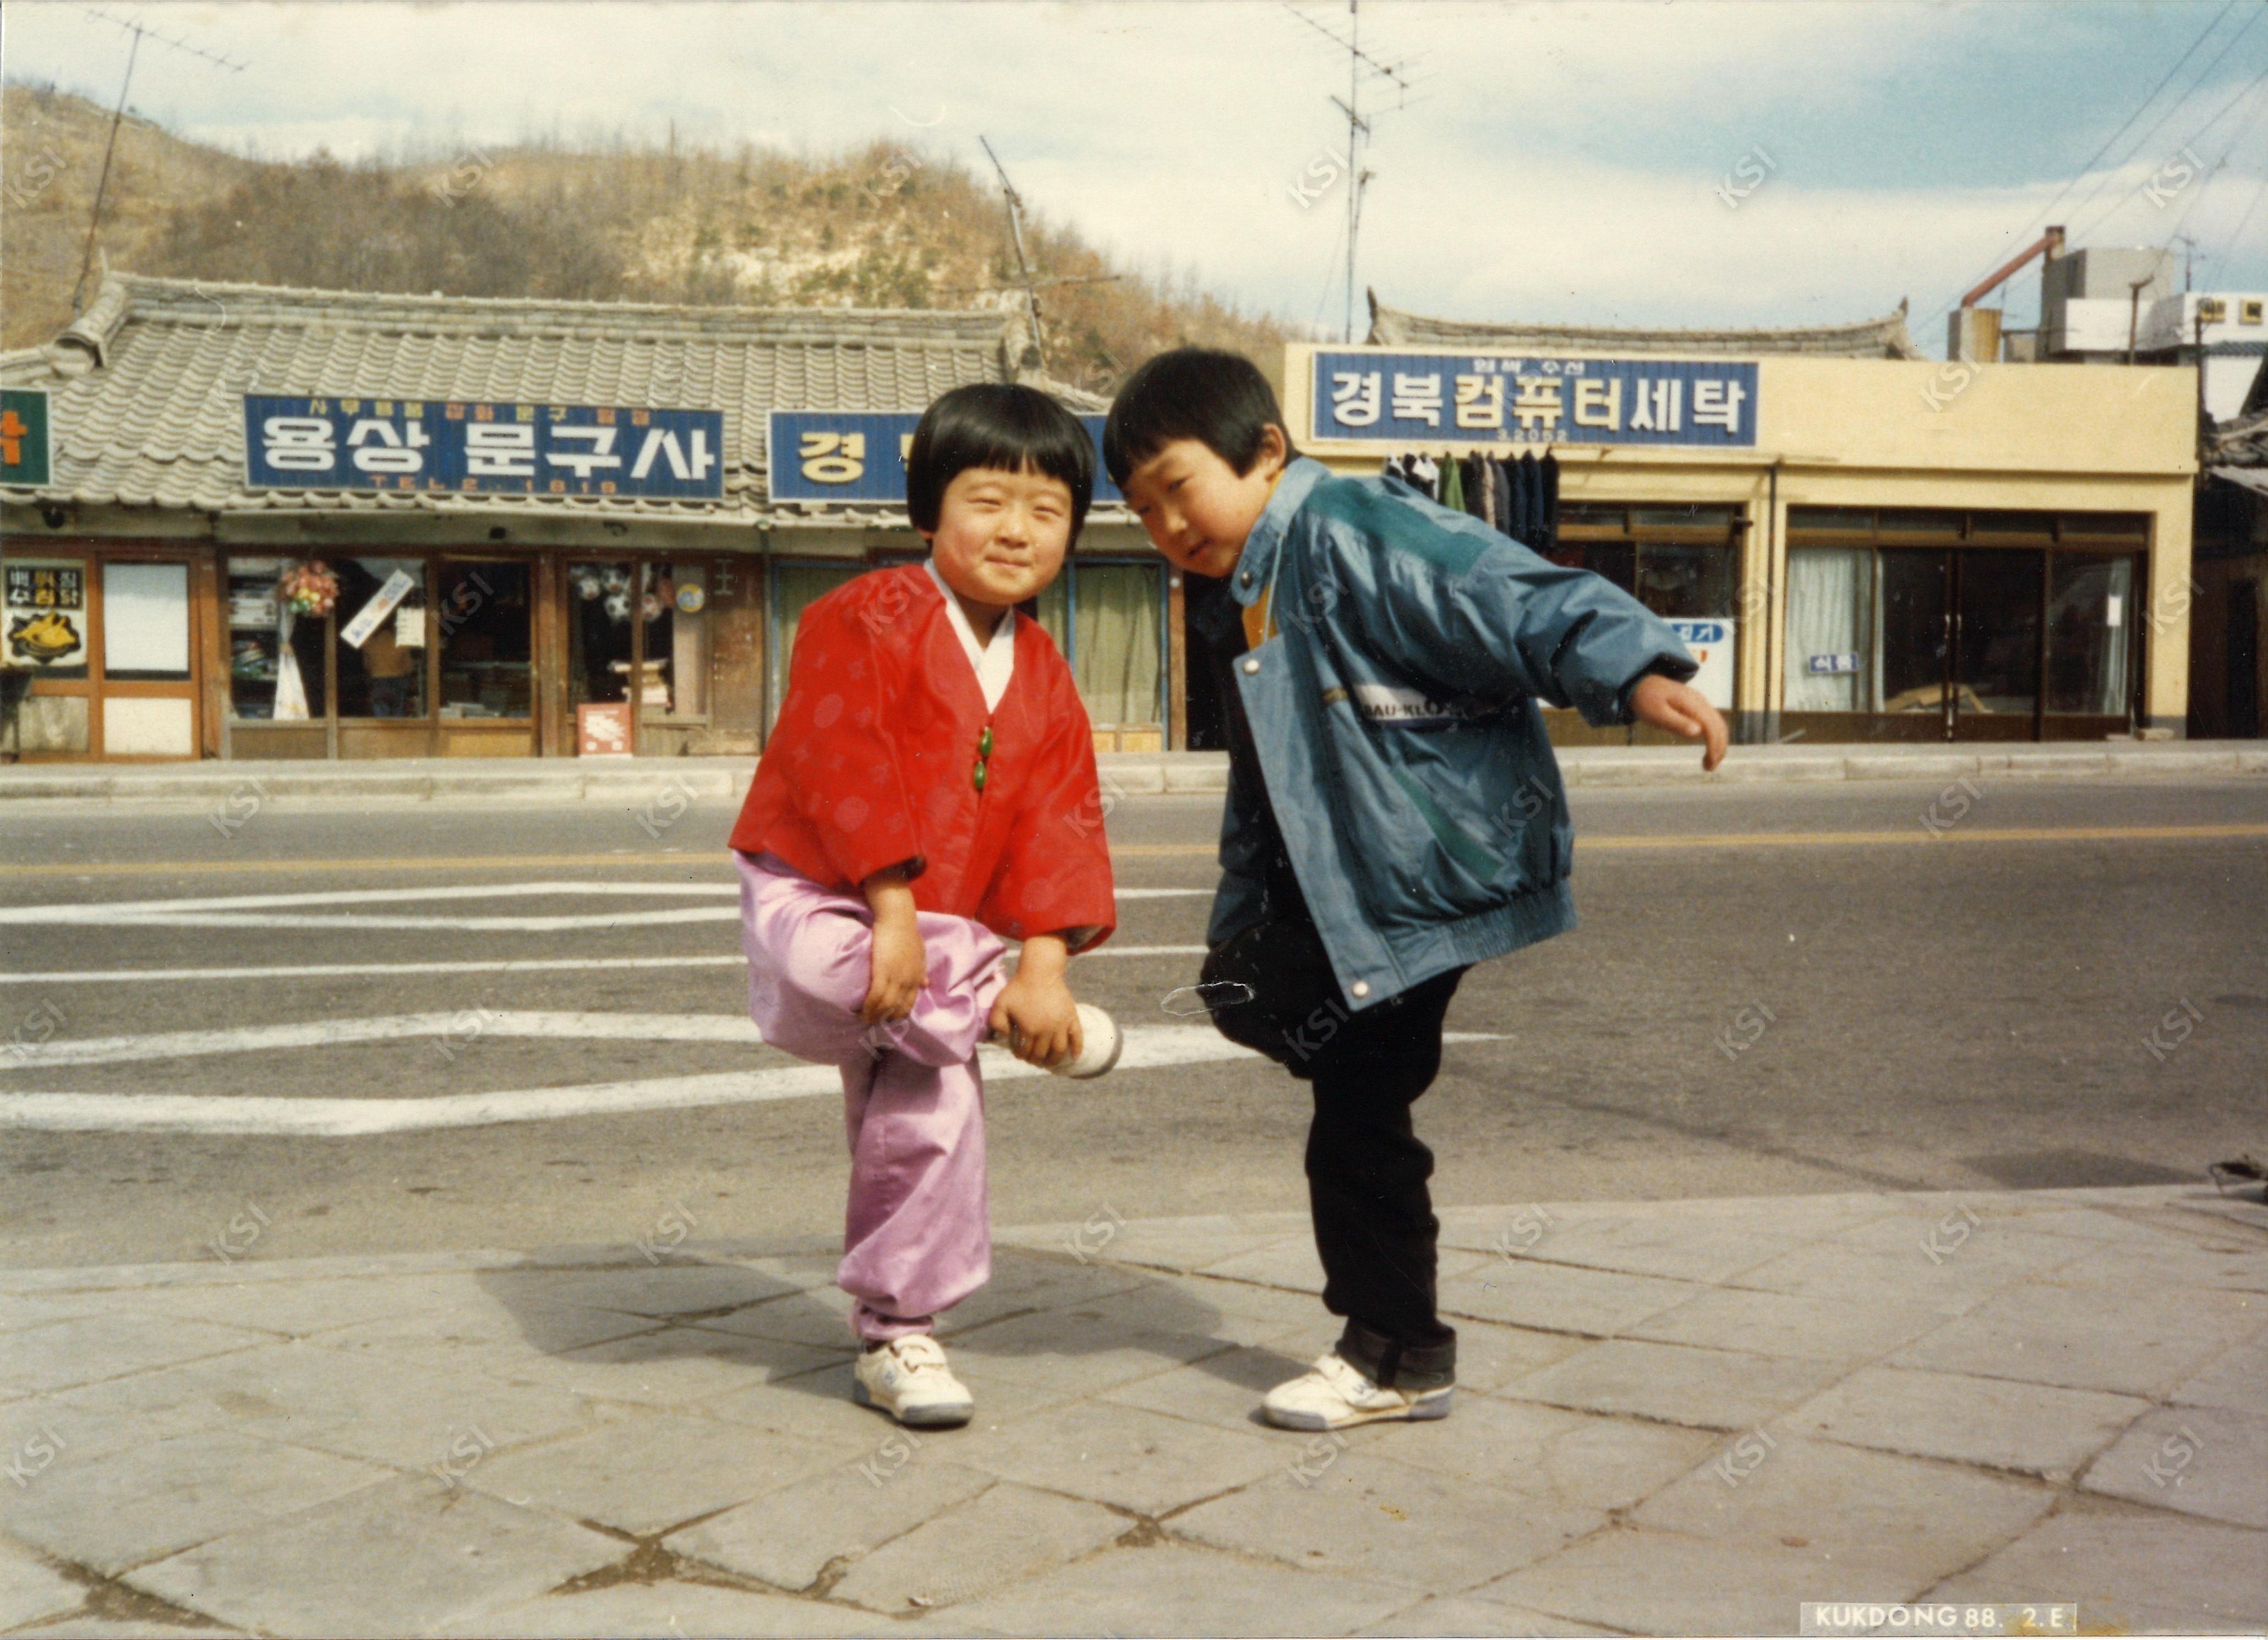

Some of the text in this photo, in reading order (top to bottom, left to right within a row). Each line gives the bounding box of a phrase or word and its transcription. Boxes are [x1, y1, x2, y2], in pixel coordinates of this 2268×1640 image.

[1332, 371, 1746, 434] 경북컴퓨터세탁
[262, 416, 715, 480] 용상 문구사
[369, 475, 446, 490] TEL
